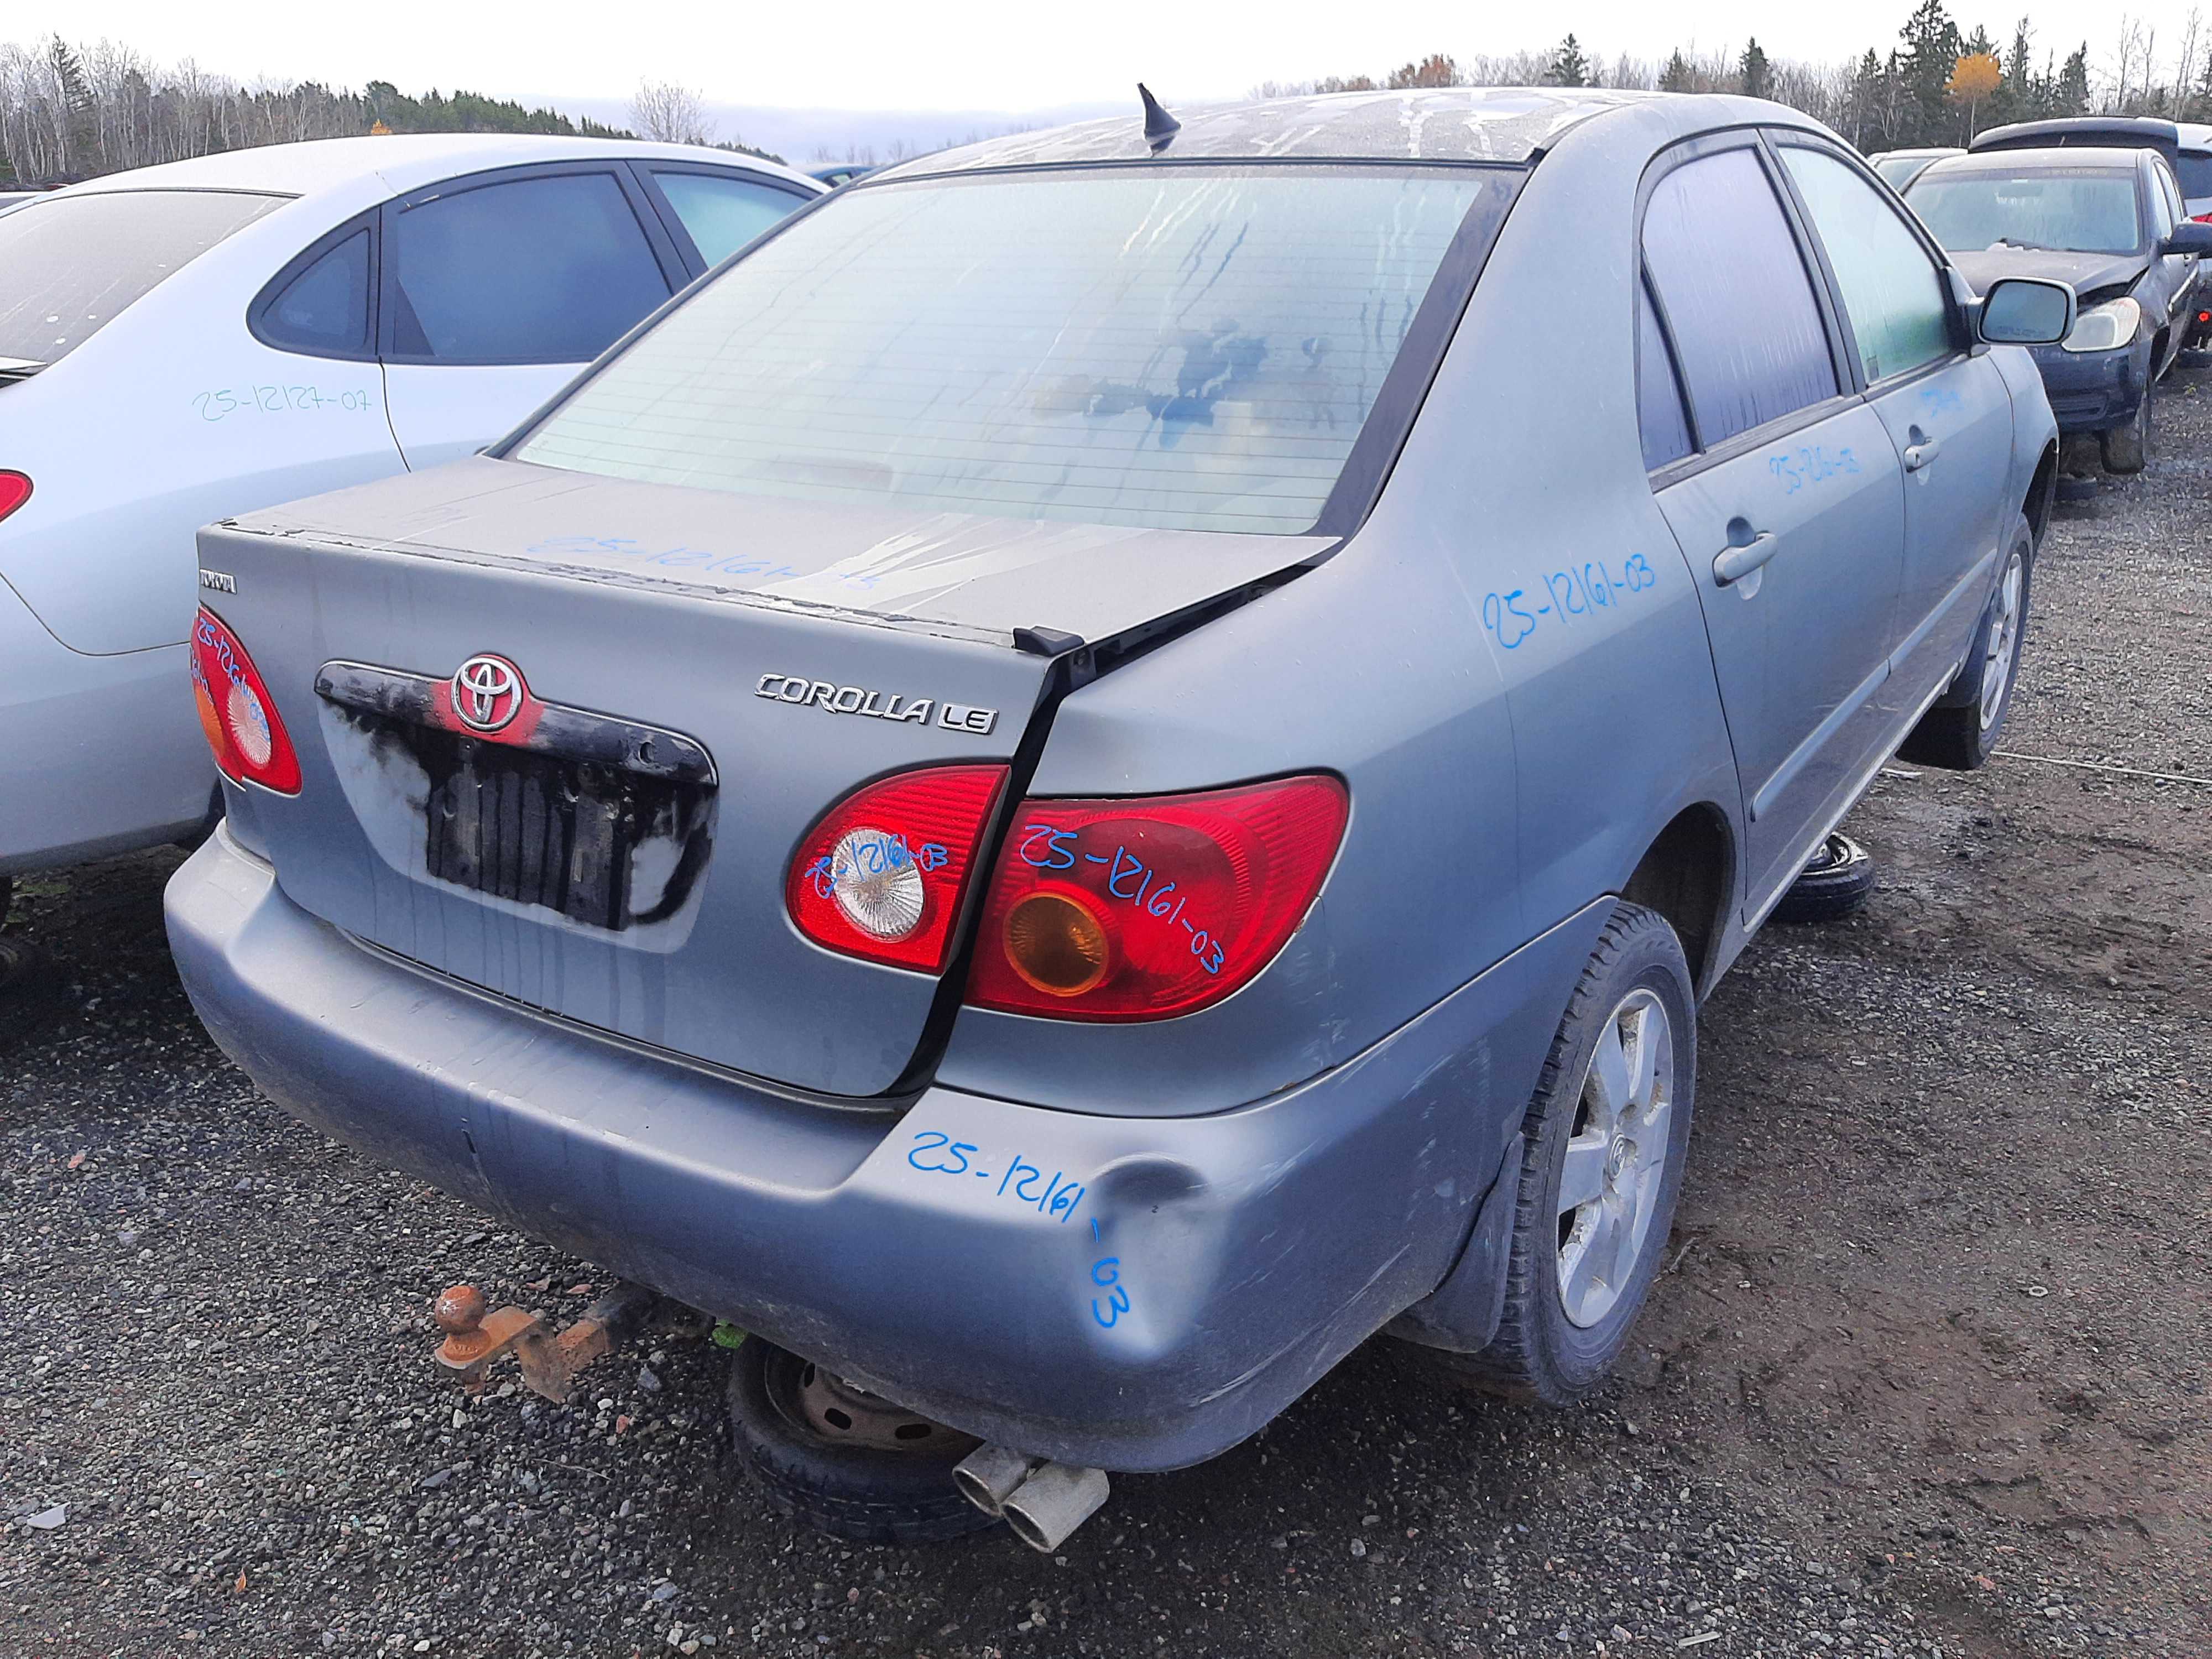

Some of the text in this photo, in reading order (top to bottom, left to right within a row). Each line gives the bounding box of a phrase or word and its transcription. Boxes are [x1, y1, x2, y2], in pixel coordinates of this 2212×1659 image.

[192, 385, 372, 421] 25-12127-07
[1483, 553, 1655, 649] 25-12161-03
[754, 673, 996, 733] COROLLA LE
[1020, 824, 1225, 975] 25-12161-03
